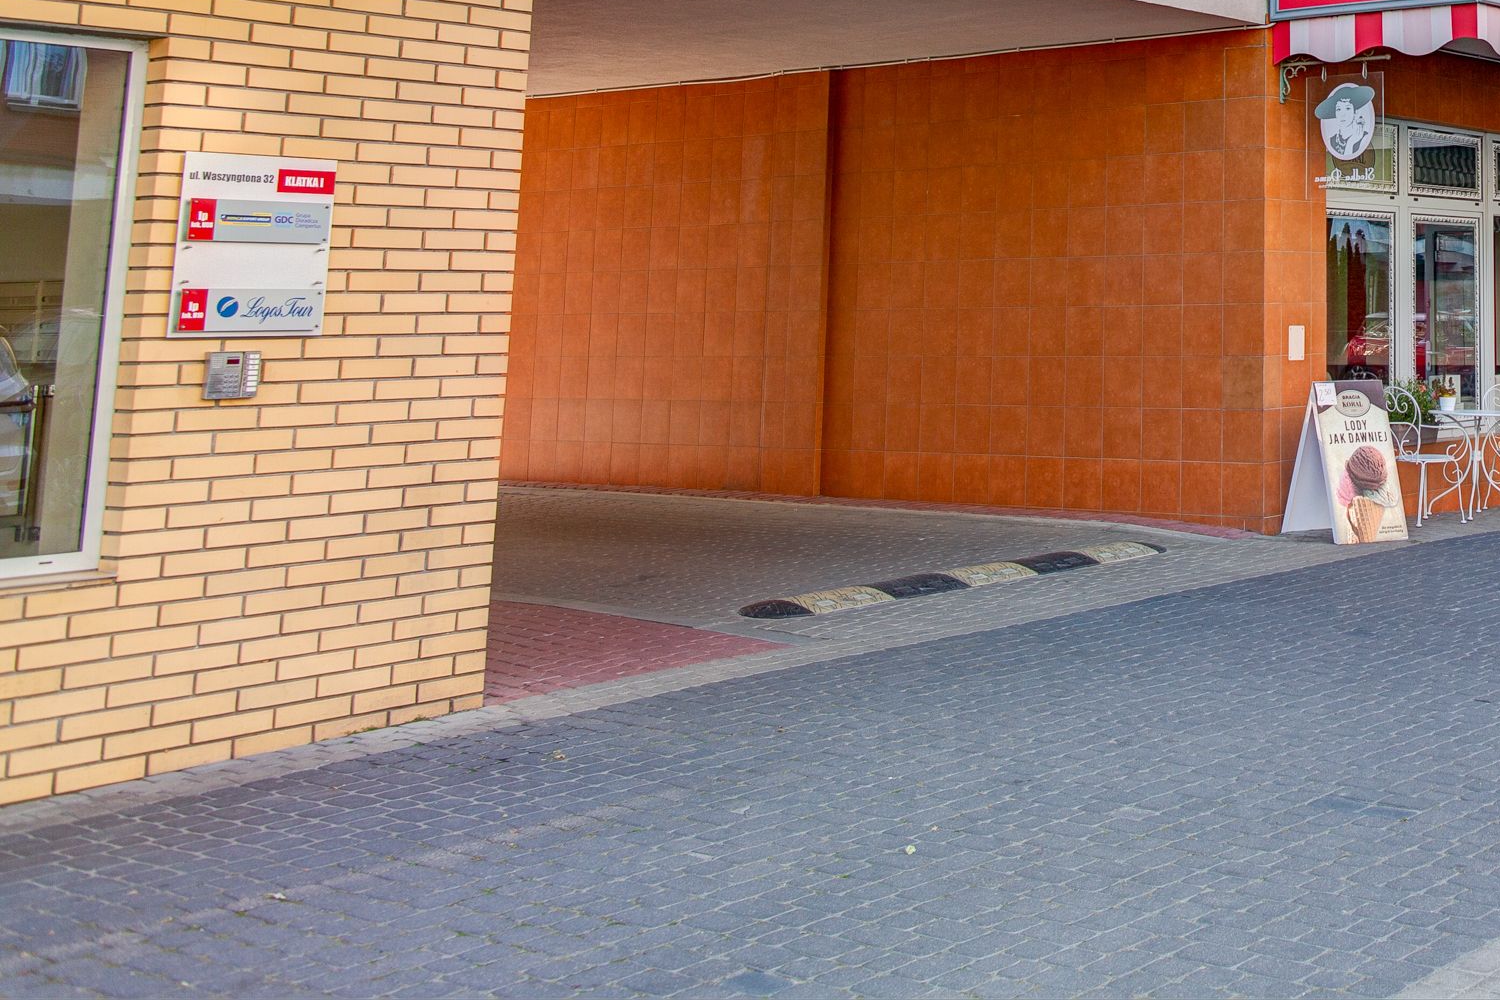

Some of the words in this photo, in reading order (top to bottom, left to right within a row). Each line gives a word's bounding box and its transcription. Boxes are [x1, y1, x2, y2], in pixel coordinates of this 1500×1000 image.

[189, 171, 200, 180] ul.
[203, 171, 262, 183] Waszyngtona
[263, 174, 275, 184] 32
[284, 176, 319, 188] KLATKA
[274, 215, 294, 224] GDC
[1344, 419, 1367, 431] LODY
[1329, 432, 1347, 445] JAK
[1348, 431, 1388, 444] DAWNIEJ
